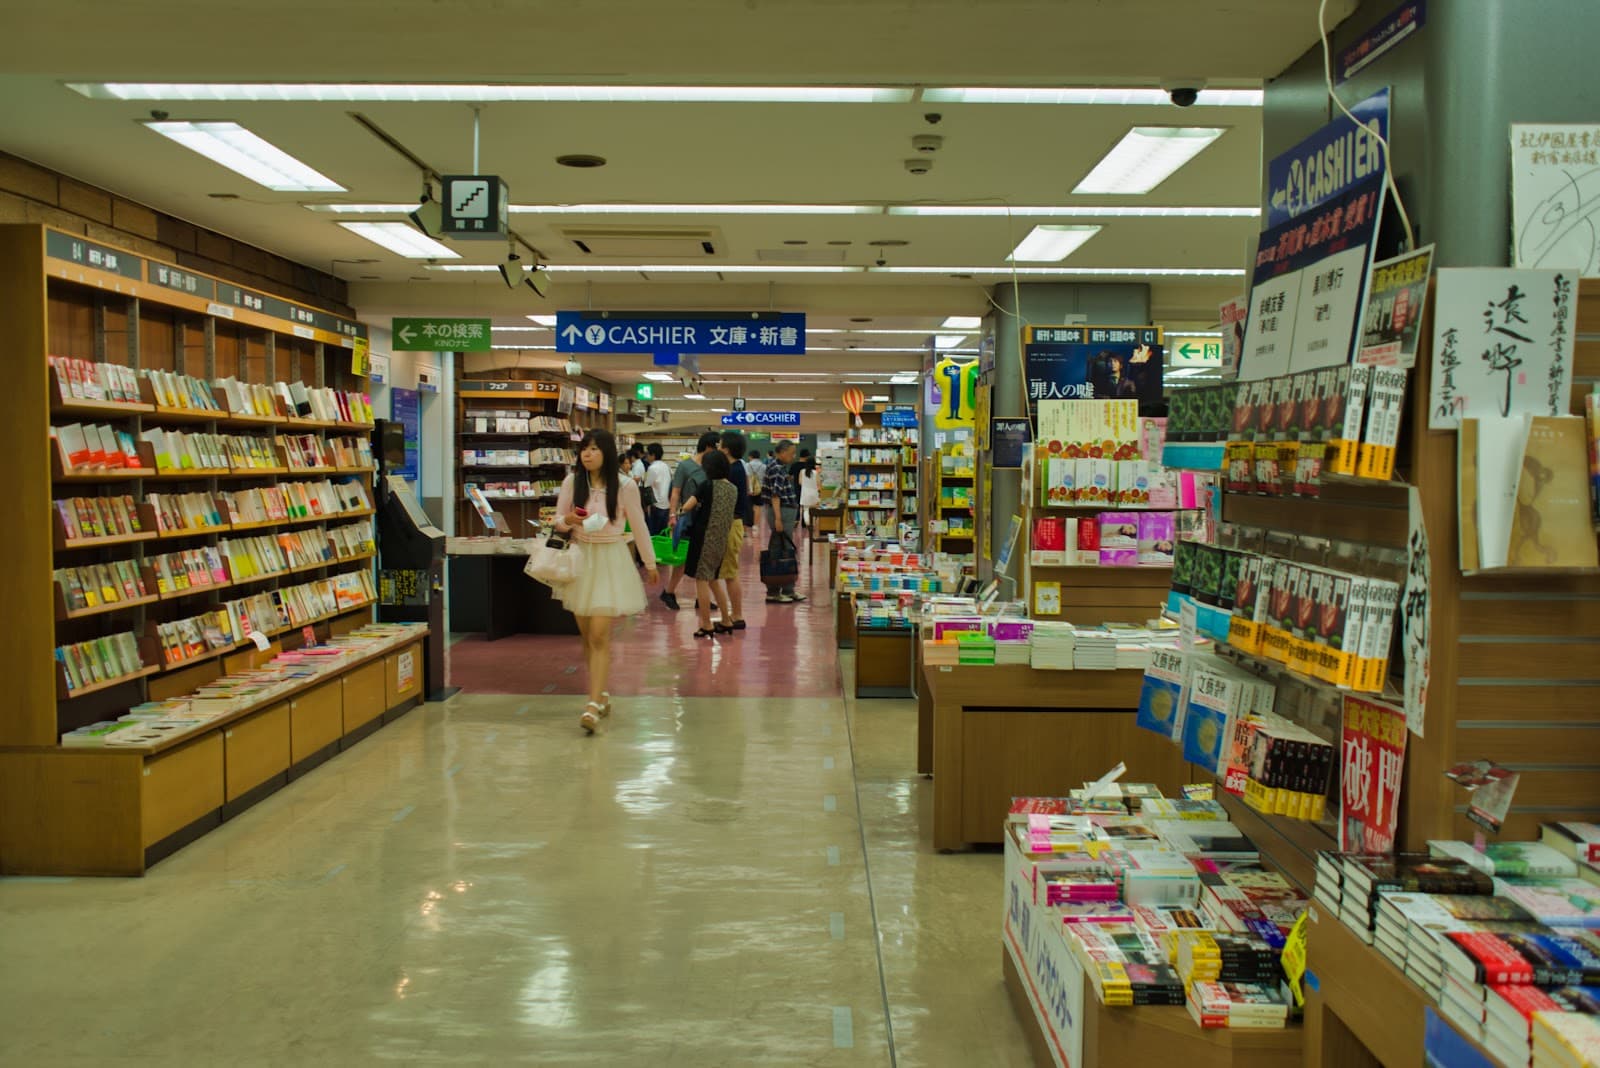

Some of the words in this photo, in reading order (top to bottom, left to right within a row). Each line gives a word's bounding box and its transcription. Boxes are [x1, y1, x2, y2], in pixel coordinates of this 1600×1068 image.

[1305, 117, 1381, 204] CASHIER
[422, 323, 483, 340] 本の検索
[608, 327, 697, 345] CASHIER
[709, 327, 799, 346] 文庫・新書
[434, 340, 471, 348] KINOナビ
[489, 382, 508, 390] フェア
[538, 383, 557, 391] フェア
[1029, 378, 1095, 399] 罪人の嘘
[755, 413, 797, 423] CASHIER
[1343, 736, 1403, 839] 破門
